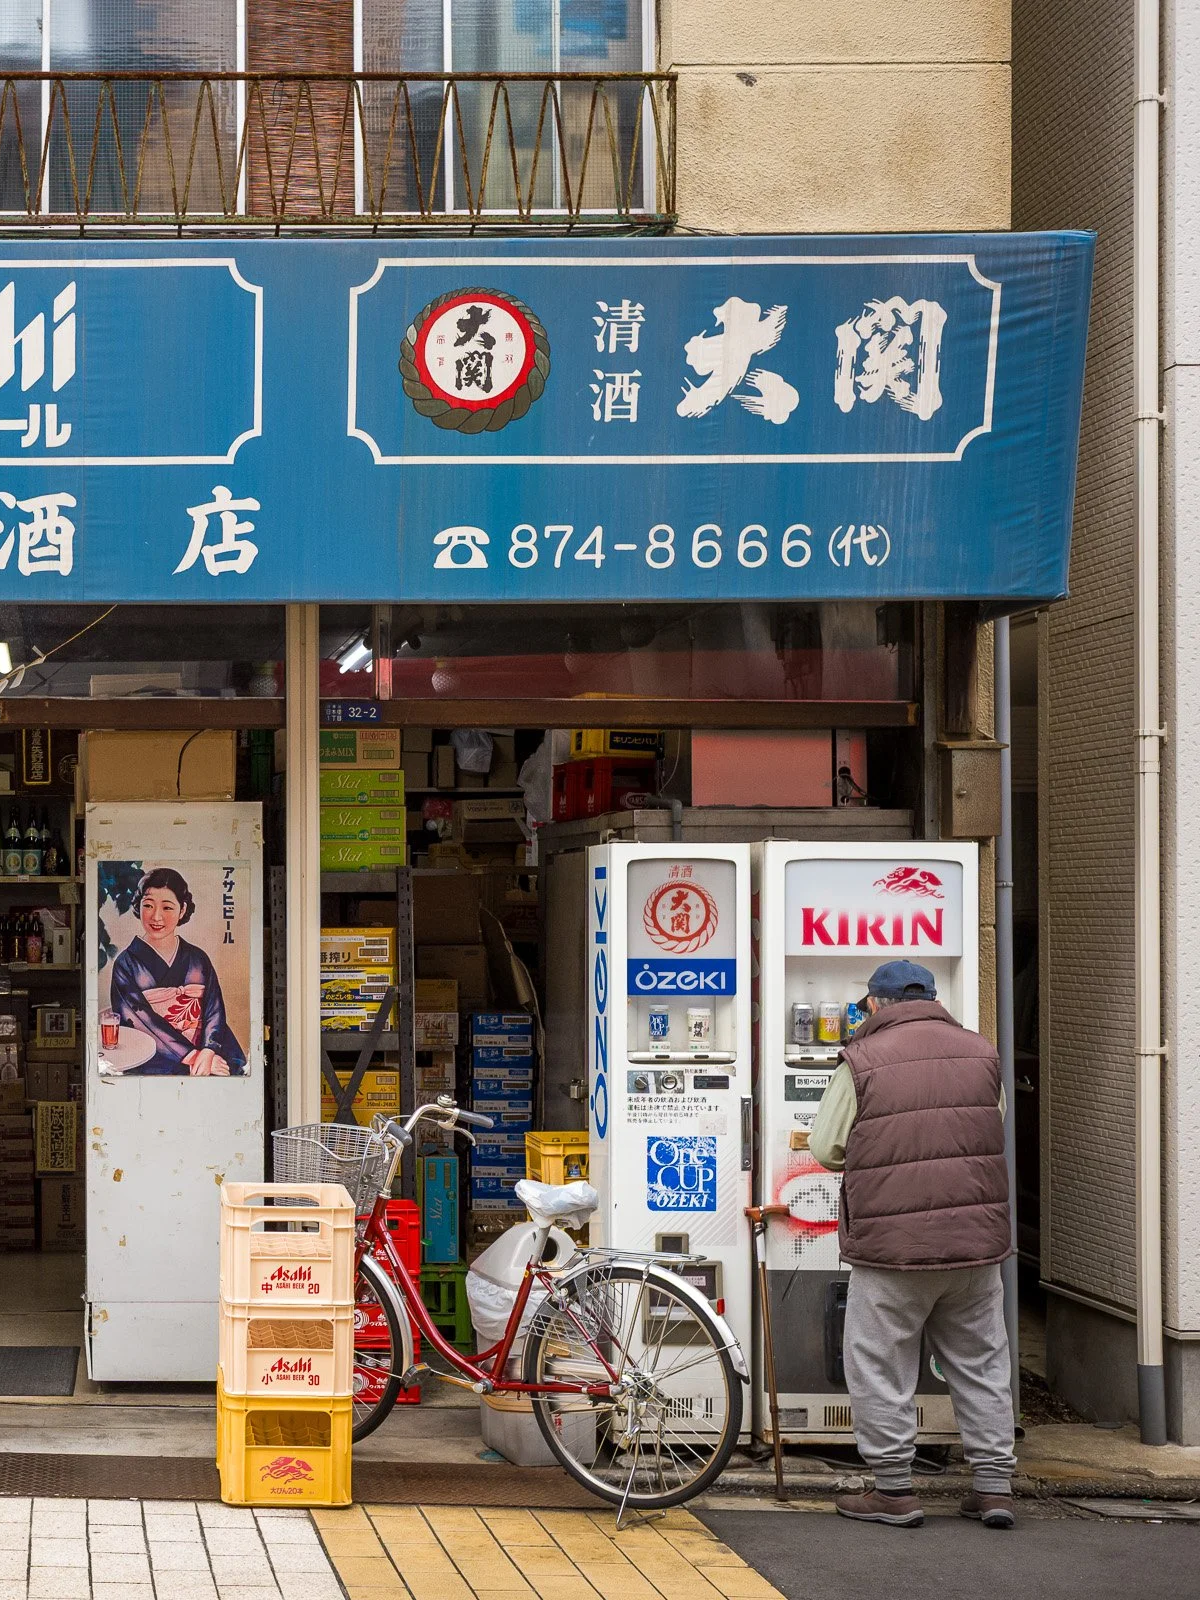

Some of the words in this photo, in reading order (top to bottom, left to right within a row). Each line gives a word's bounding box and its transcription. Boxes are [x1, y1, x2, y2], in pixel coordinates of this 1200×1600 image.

[453, 305, 497, 393] 大関
[592, 300, 646, 423] 清酒
[677, 296, 948, 421] 大関
[348, 707, 377, 718] 32-2
[613, 736, 657, 745] キリンビバレ
[31, 729, 44, 780] 波屋矢野商店
[669, 865, 693, 878] 清酒
[222, 866, 235, 944] アサヒビール
[670, 890, 691, 934] 大関
[801, 908, 944, 947] KIRIN
[320, 952, 351, 963] 番搾り
[824, 1018, 840, 1032] 新
[650, 1140, 709, 1166] One
[657, 1165, 714, 1193] CUP
[656, 1192, 709, 1208] OZEKI
[270, 1265, 312, 1282] Asahi
[261, 1283, 273, 1295] 中
[292, 1282, 305, 1290] BEER
[308, 1284, 320, 1295] 20
[270, 1357, 312, 1373] Asahi
[261, 1374, 273, 1386] 小
[308, 1375, 320, 1386] 30
[270, 1487, 304, 1495] 大びん20本
